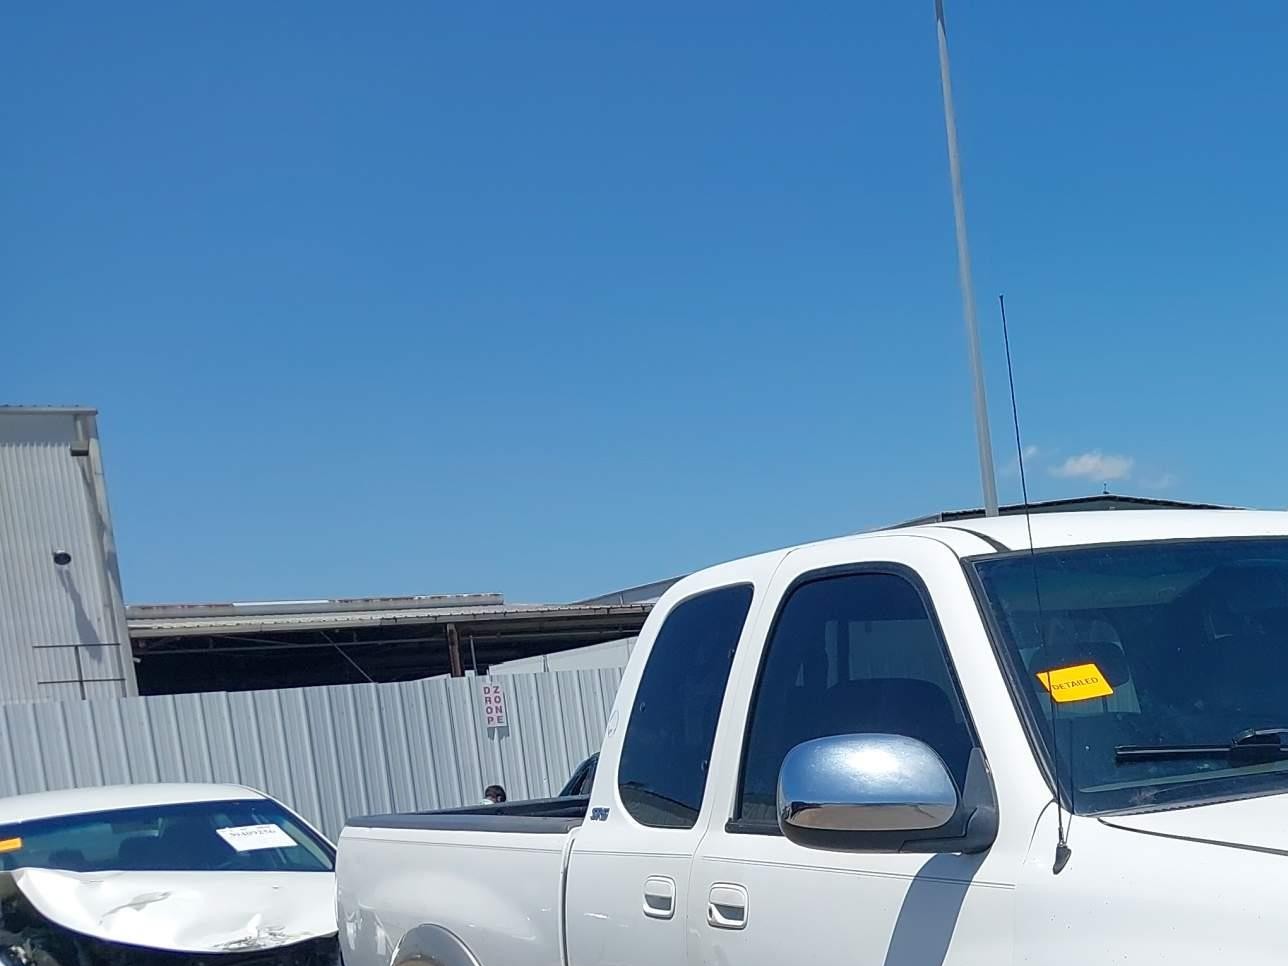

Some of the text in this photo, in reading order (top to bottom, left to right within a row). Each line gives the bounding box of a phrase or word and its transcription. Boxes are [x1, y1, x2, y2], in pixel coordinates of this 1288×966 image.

[1052, 677, 1099, 690] DETAILED
[483, 686, 494, 725] DROP
[493, 686, 504, 724] ZONE
